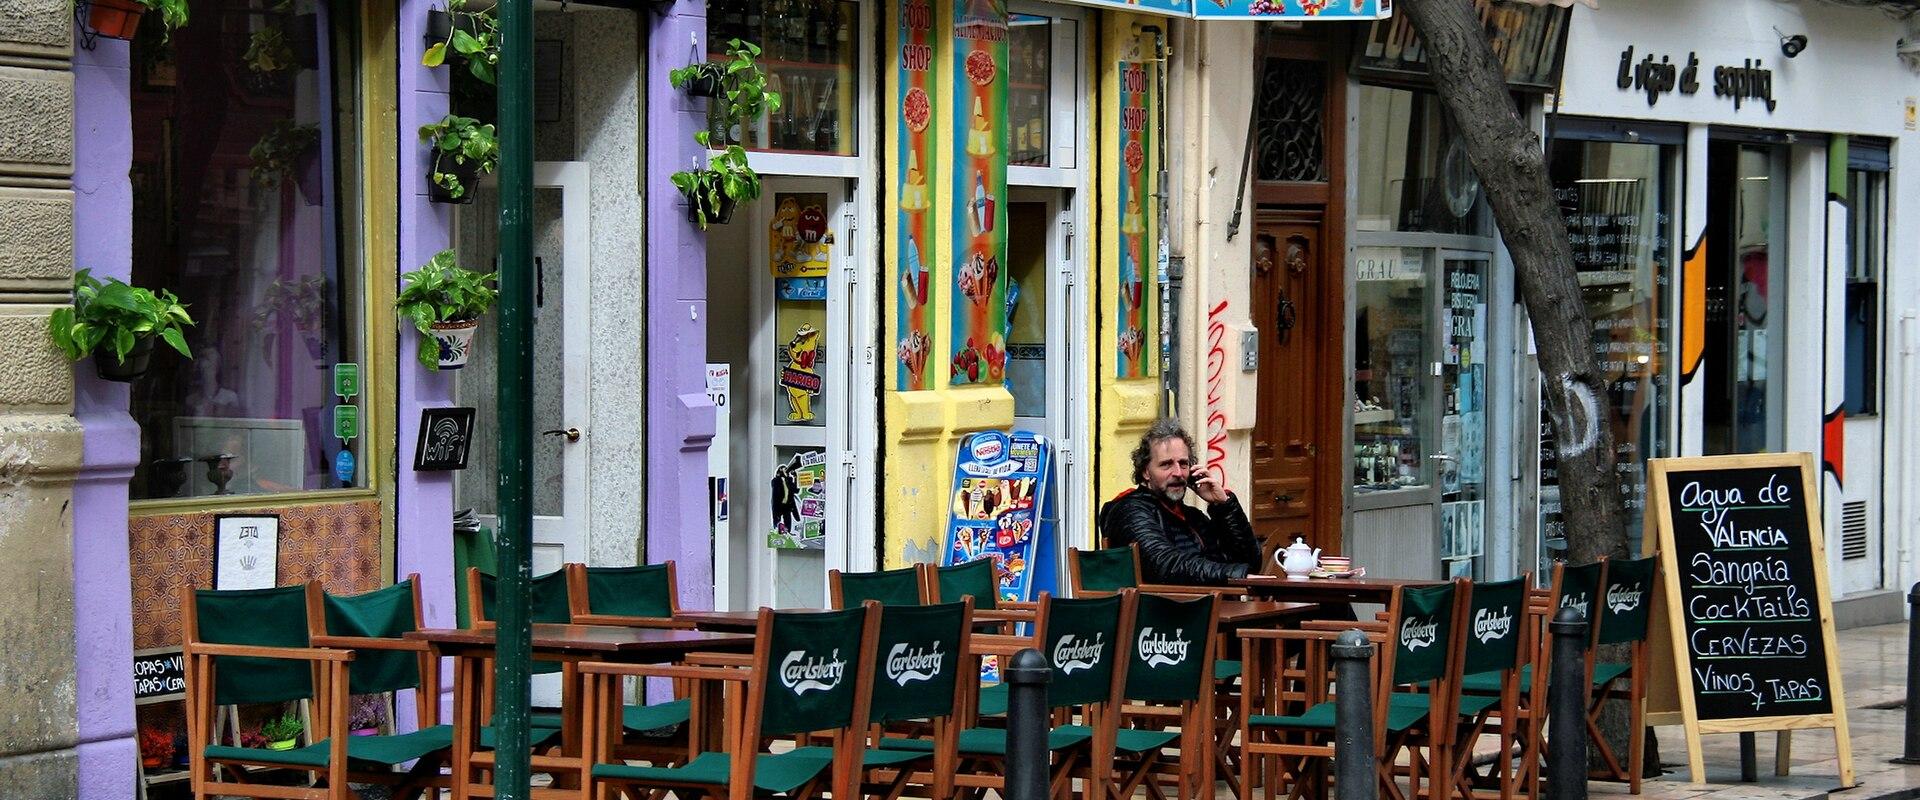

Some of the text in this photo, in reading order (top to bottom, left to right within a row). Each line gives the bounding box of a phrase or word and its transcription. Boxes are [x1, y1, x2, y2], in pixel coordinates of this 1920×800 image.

[901, 4, 931, 30] FOOD
[902, 44, 932, 71] SHOP
[1122, 69, 1147, 93] FOOD
[1617, 45, 1633, 88] il
[1635, 53, 1676, 106] vizio
[1679, 51, 1699, 94] di
[1122, 107, 1147, 132] SHOP
[1356, 259, 1397, 279] GRAU
[1451, 315, 1474, 337] GRA
[783, 371, 820, 390] HARIBO
[1758, 474, 1791, 503] de
[1607, 582, 1643, 612] Carlsberg
[1401, 616, 1438, 649] Carlsberg
[1474, 606, 1512, 642] Carlsberg
[1053, 633, 1104, 671] Carlsberg
[1138, 627, 1188, 665] Carlsberg
[1692, 627, 1807, 656] CERVEZAS
[134, 656, 185, 676] OPAS VI
[780, 649, 847, 692] Carlsberg
[886, 641, 945, 683] Carlsberg
[134, 676, 162, 694] TAPAS
[1765, 678, 1822, 700] TAPAS
